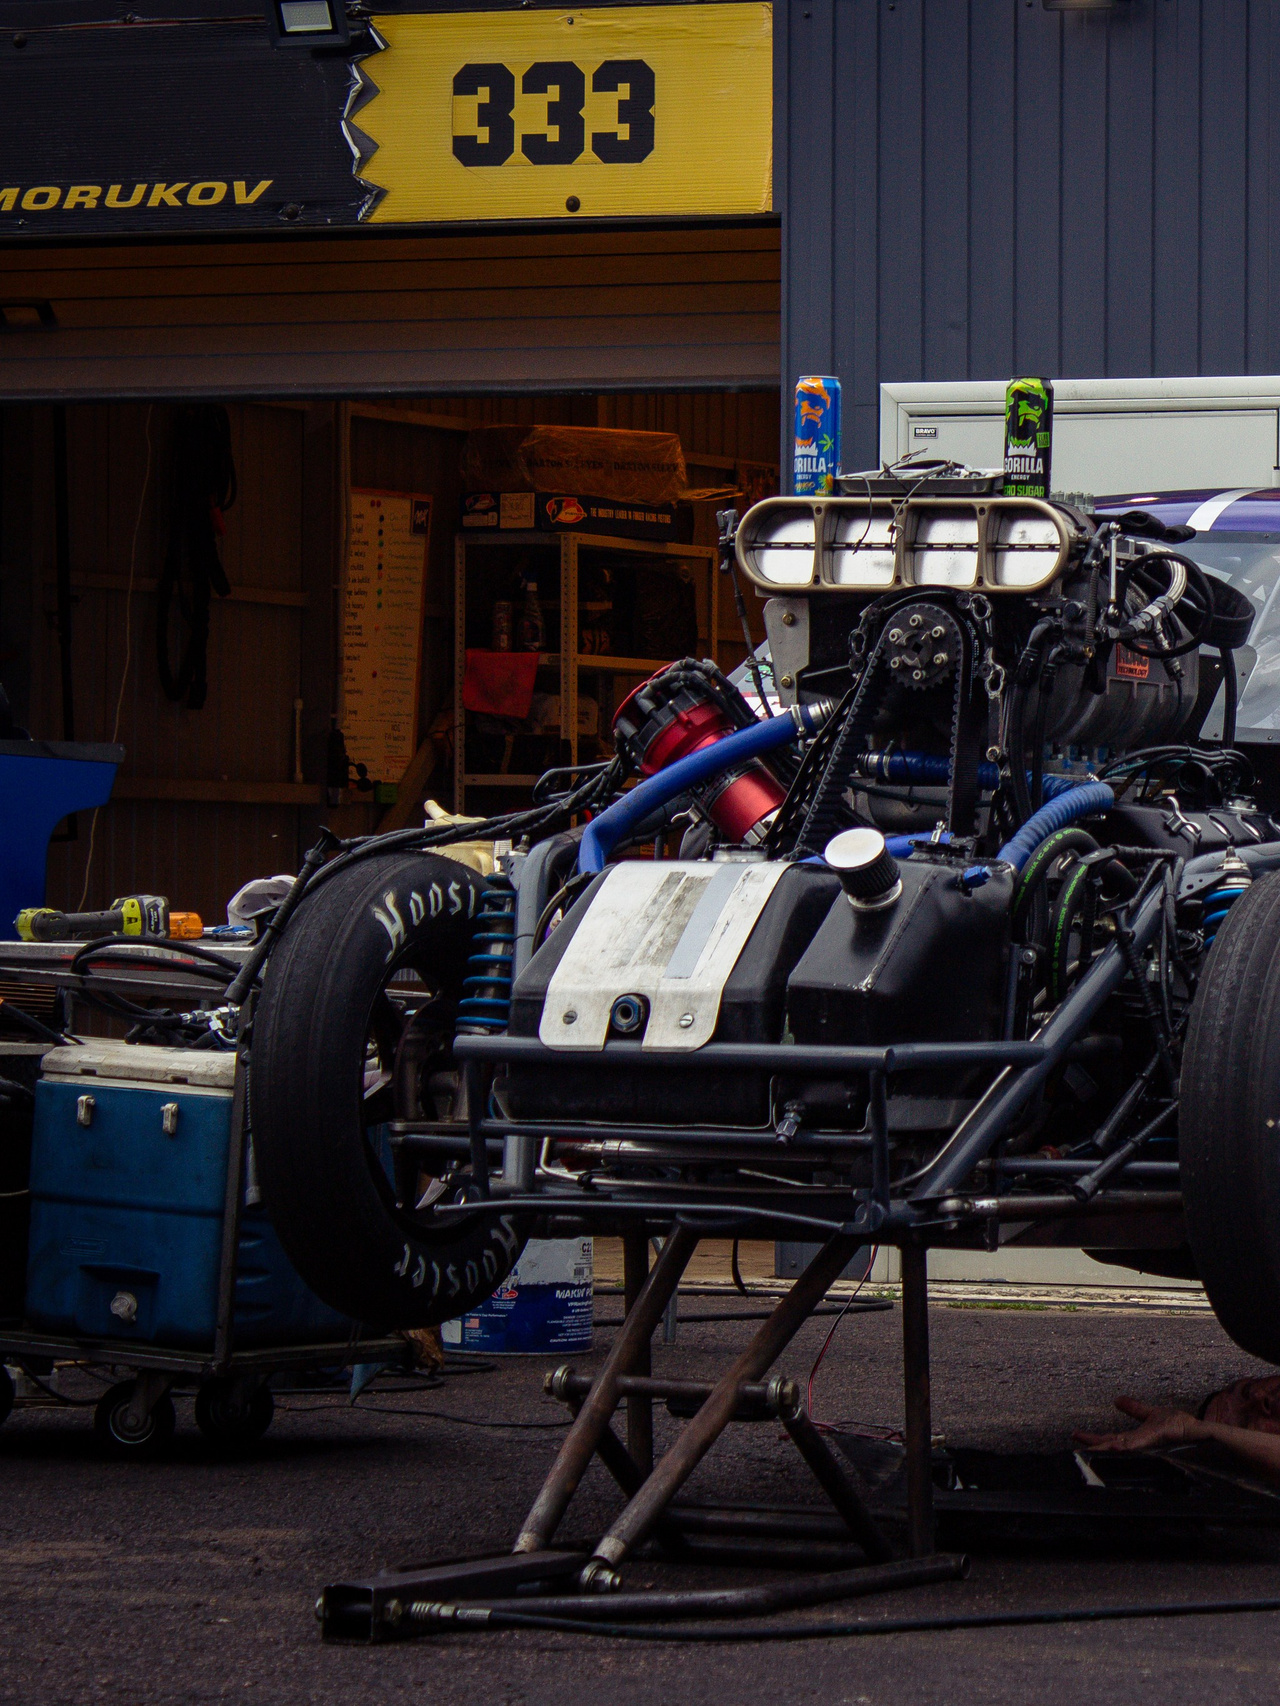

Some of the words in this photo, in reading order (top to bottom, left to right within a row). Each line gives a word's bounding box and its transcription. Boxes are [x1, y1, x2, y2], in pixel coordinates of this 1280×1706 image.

[452, 59, 655, 167] 333
[1017, 485, 1045, 498] SUGAR
[372, 868, 477, 965] Hoosi
